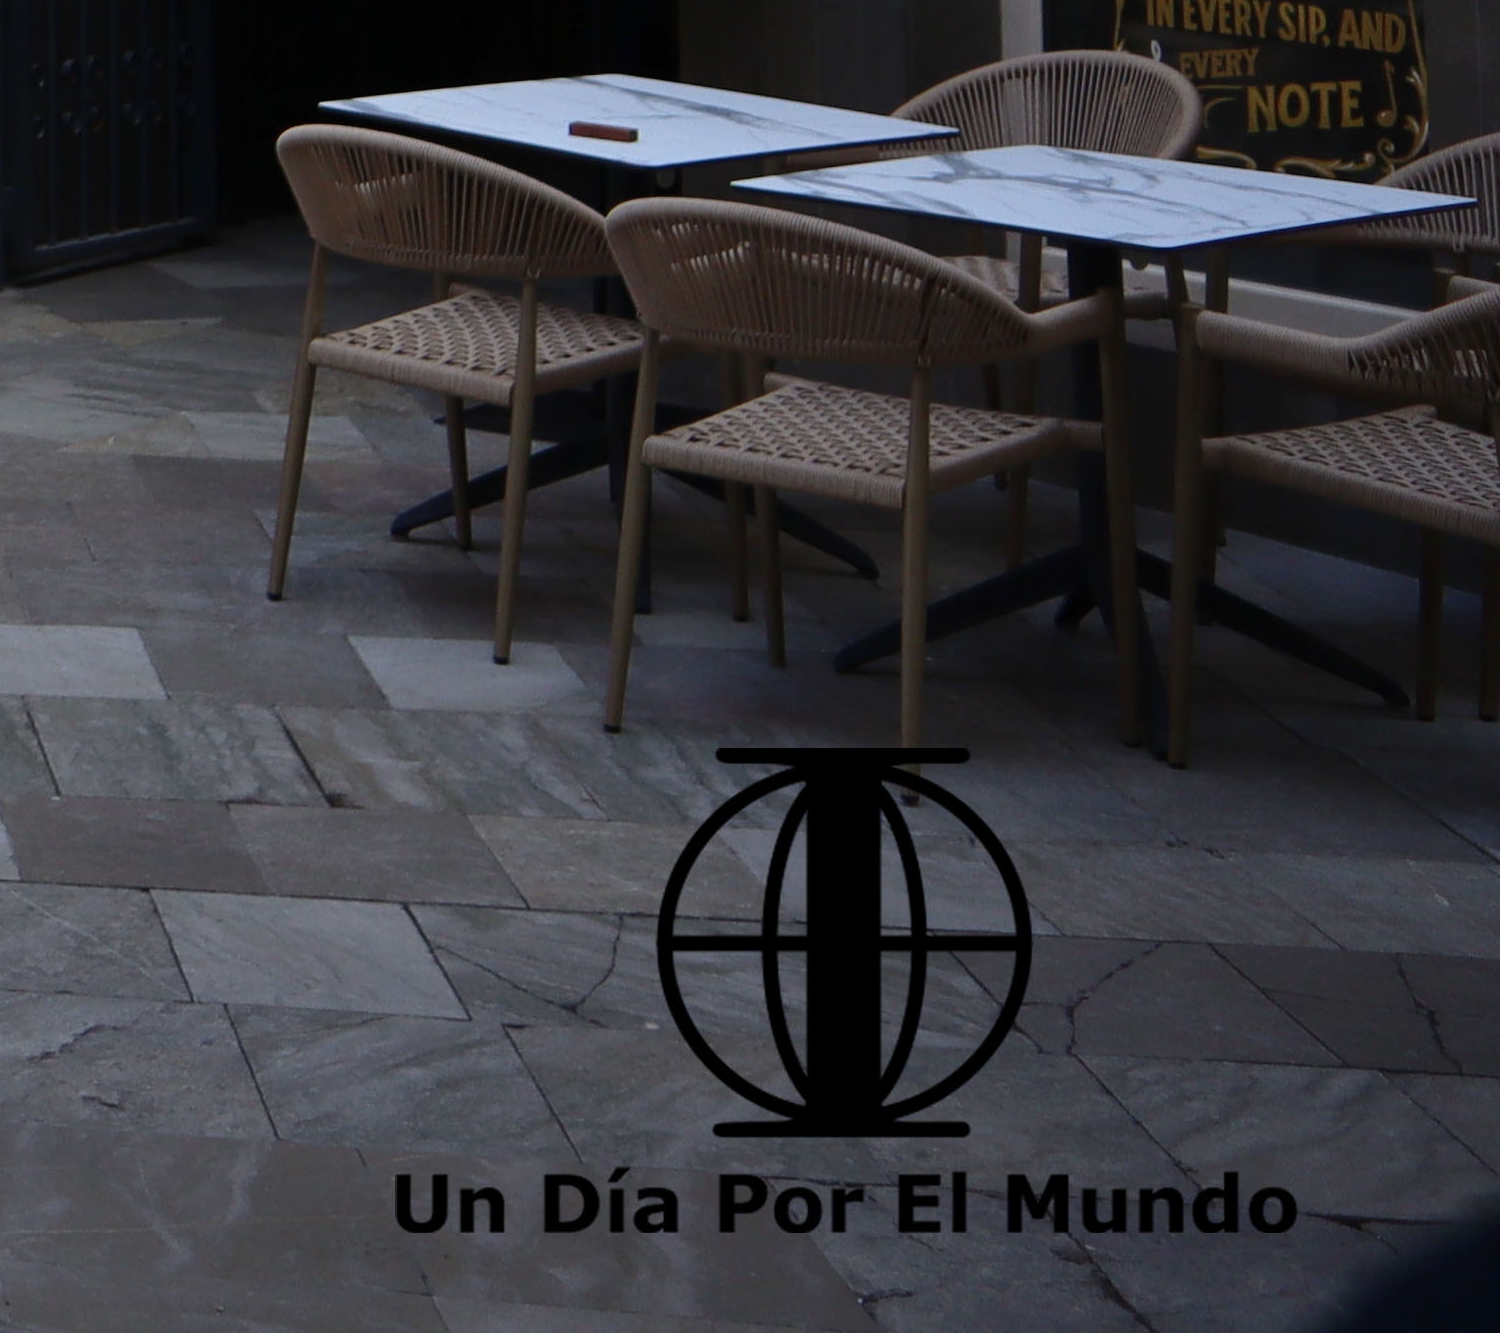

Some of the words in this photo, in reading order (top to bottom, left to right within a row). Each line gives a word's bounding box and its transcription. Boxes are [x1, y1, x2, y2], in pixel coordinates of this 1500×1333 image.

[1338, 8, 1407, 54] AND
[1179, 47, 1260, 79] EVERY
[1246, 81, 1364, 133] NOTE
